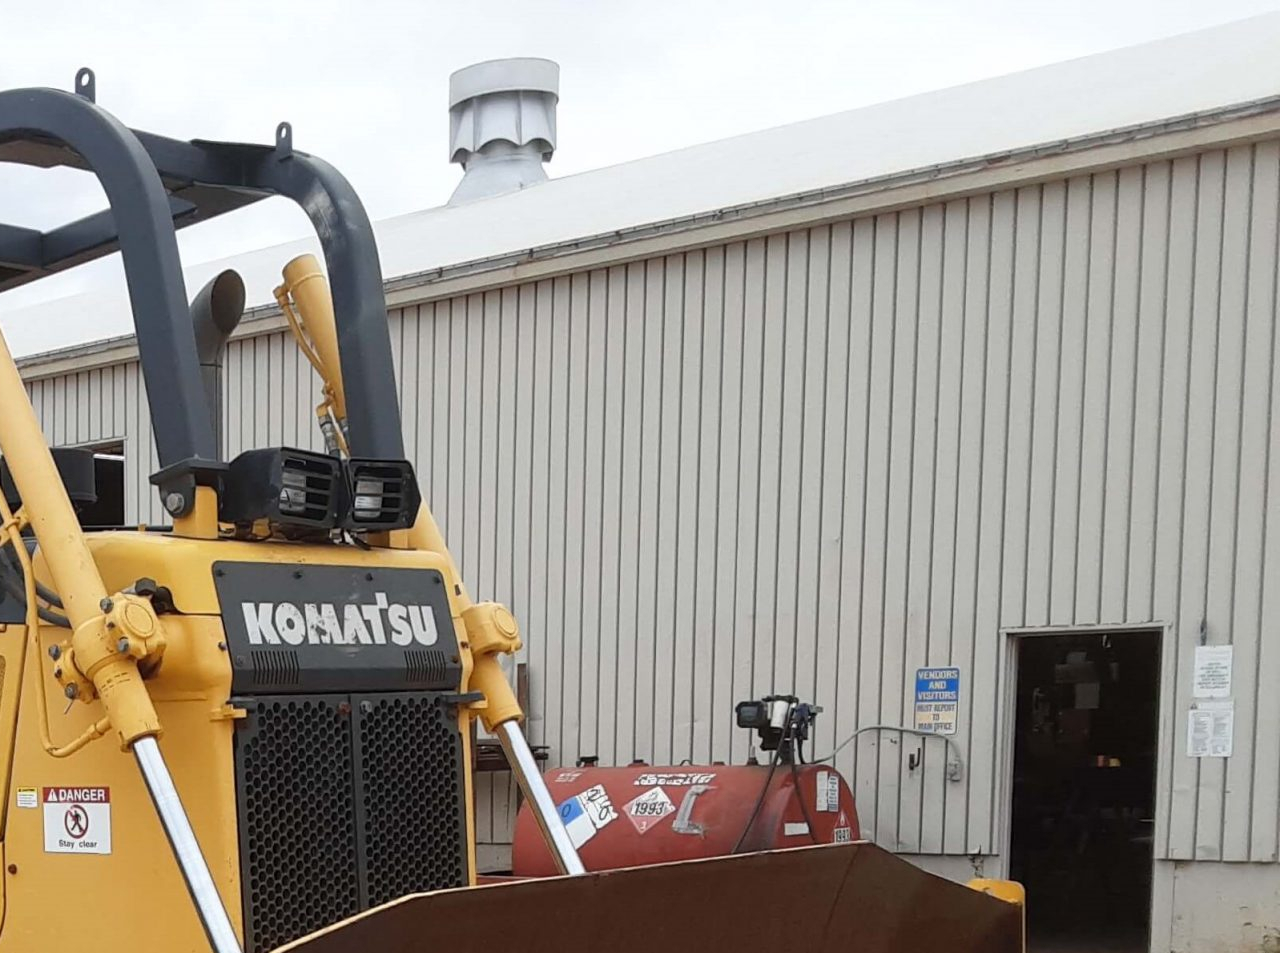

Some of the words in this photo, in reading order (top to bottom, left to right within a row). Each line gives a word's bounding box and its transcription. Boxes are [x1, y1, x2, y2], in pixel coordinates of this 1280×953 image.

[241, 592, 438, 646] KOMATSU
[918, 671, 958, 680] VENDORS
[928, 681, 947, 690] AND
[917, 691, 957, 700] VISITORS
[934, 703, 955, 712] REPORT
[933, 713, 940, 721] TO
[934, 722, 953, 731] OFFICE
[59, 789, 106, 801] DANGER
[634, 800, 666, 815] 1993
[59, 840, 75, 849] Stay
[79, 840, 98, 848] clear
